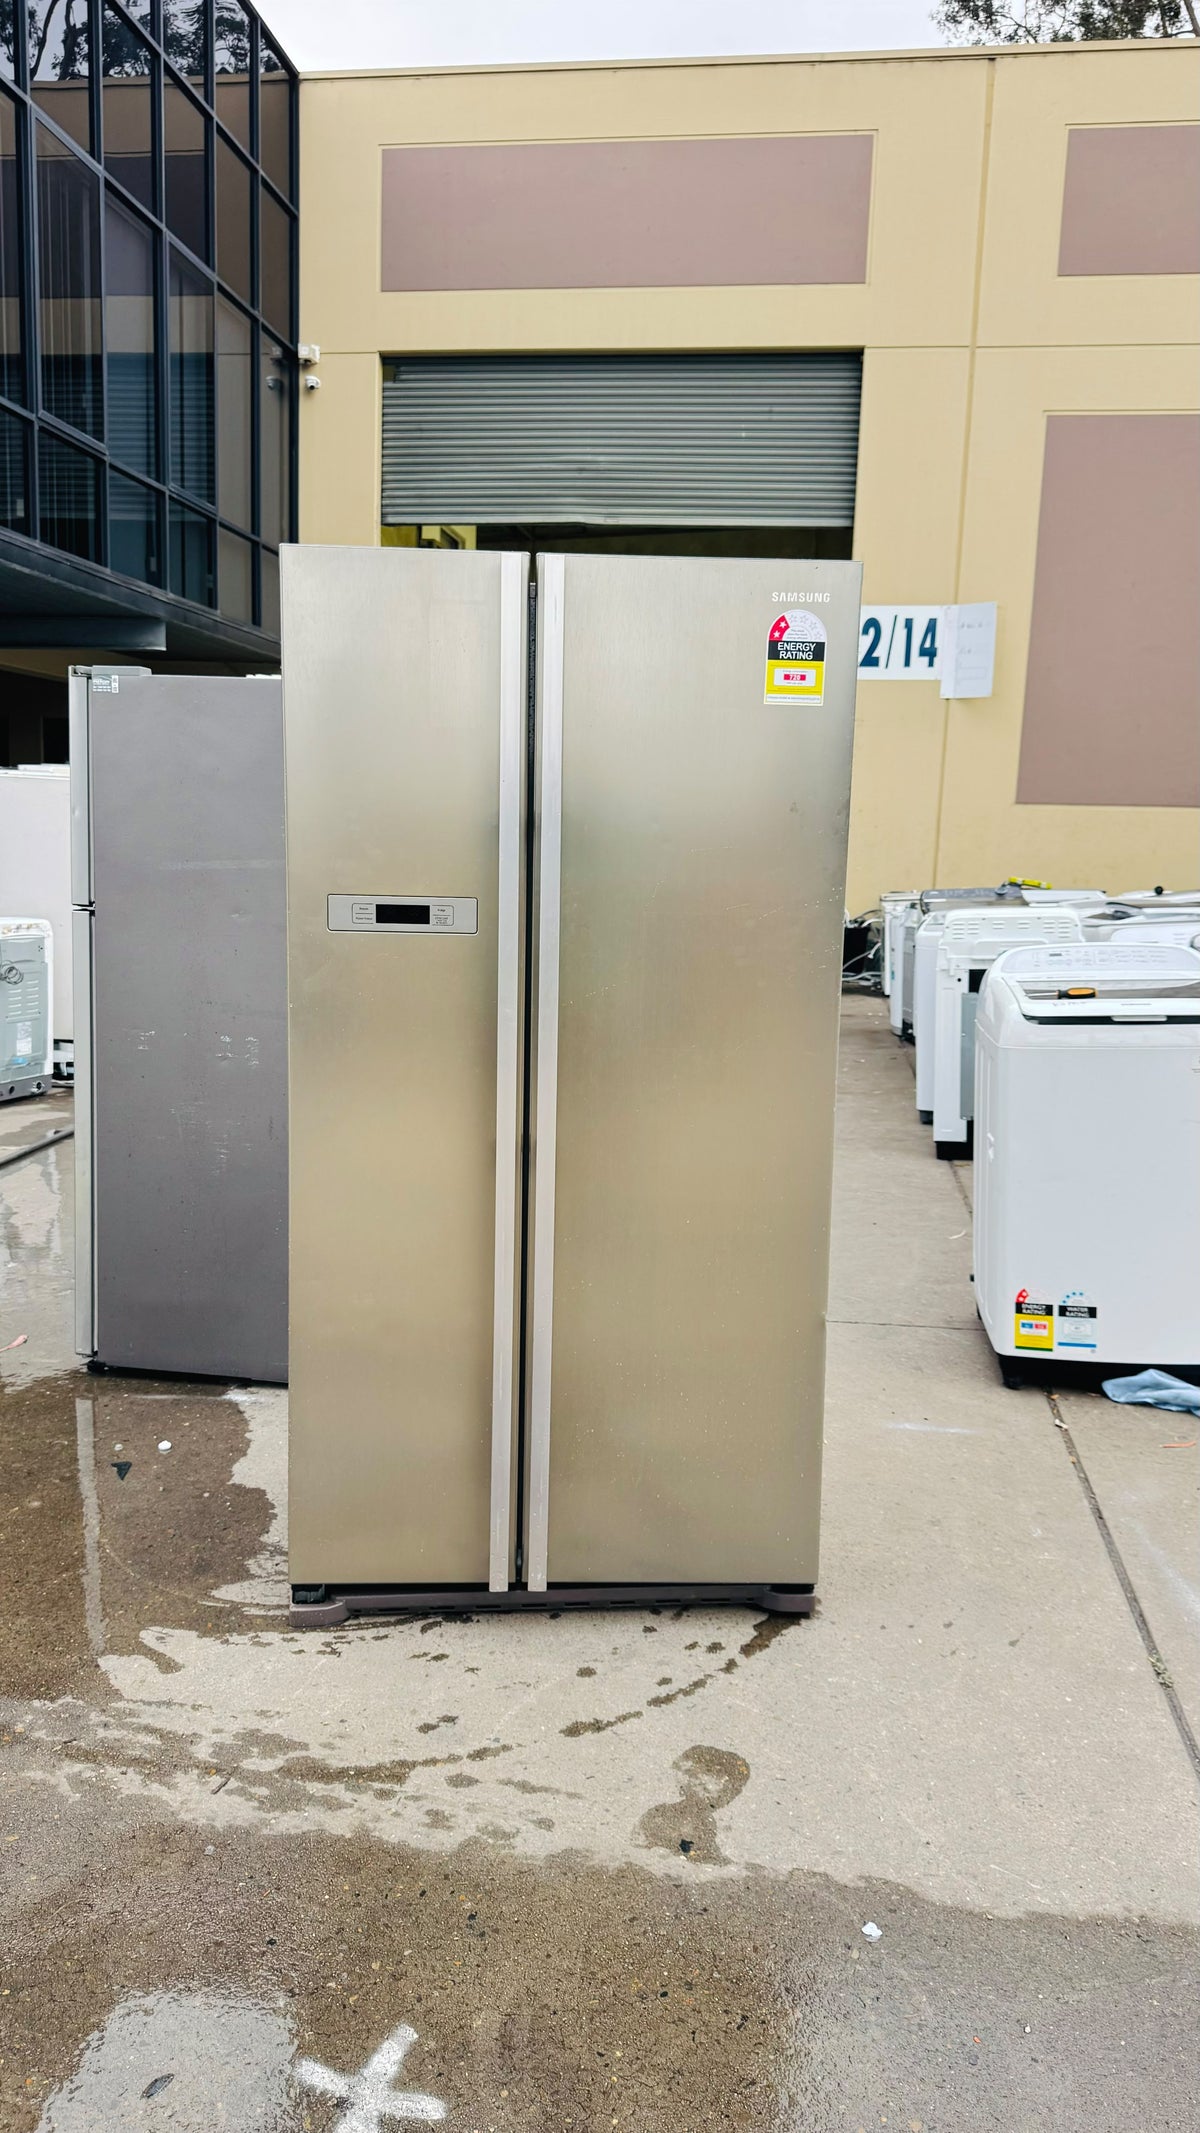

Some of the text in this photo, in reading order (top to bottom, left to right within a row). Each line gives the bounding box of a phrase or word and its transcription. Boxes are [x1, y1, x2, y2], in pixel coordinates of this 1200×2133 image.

[771, 591, 831, 603] SAMSUNG
[777, 642, 816, 652] ENERGY
[859, 614, 938, 669] 2/14
[779, 651, 813, 660] RATING
